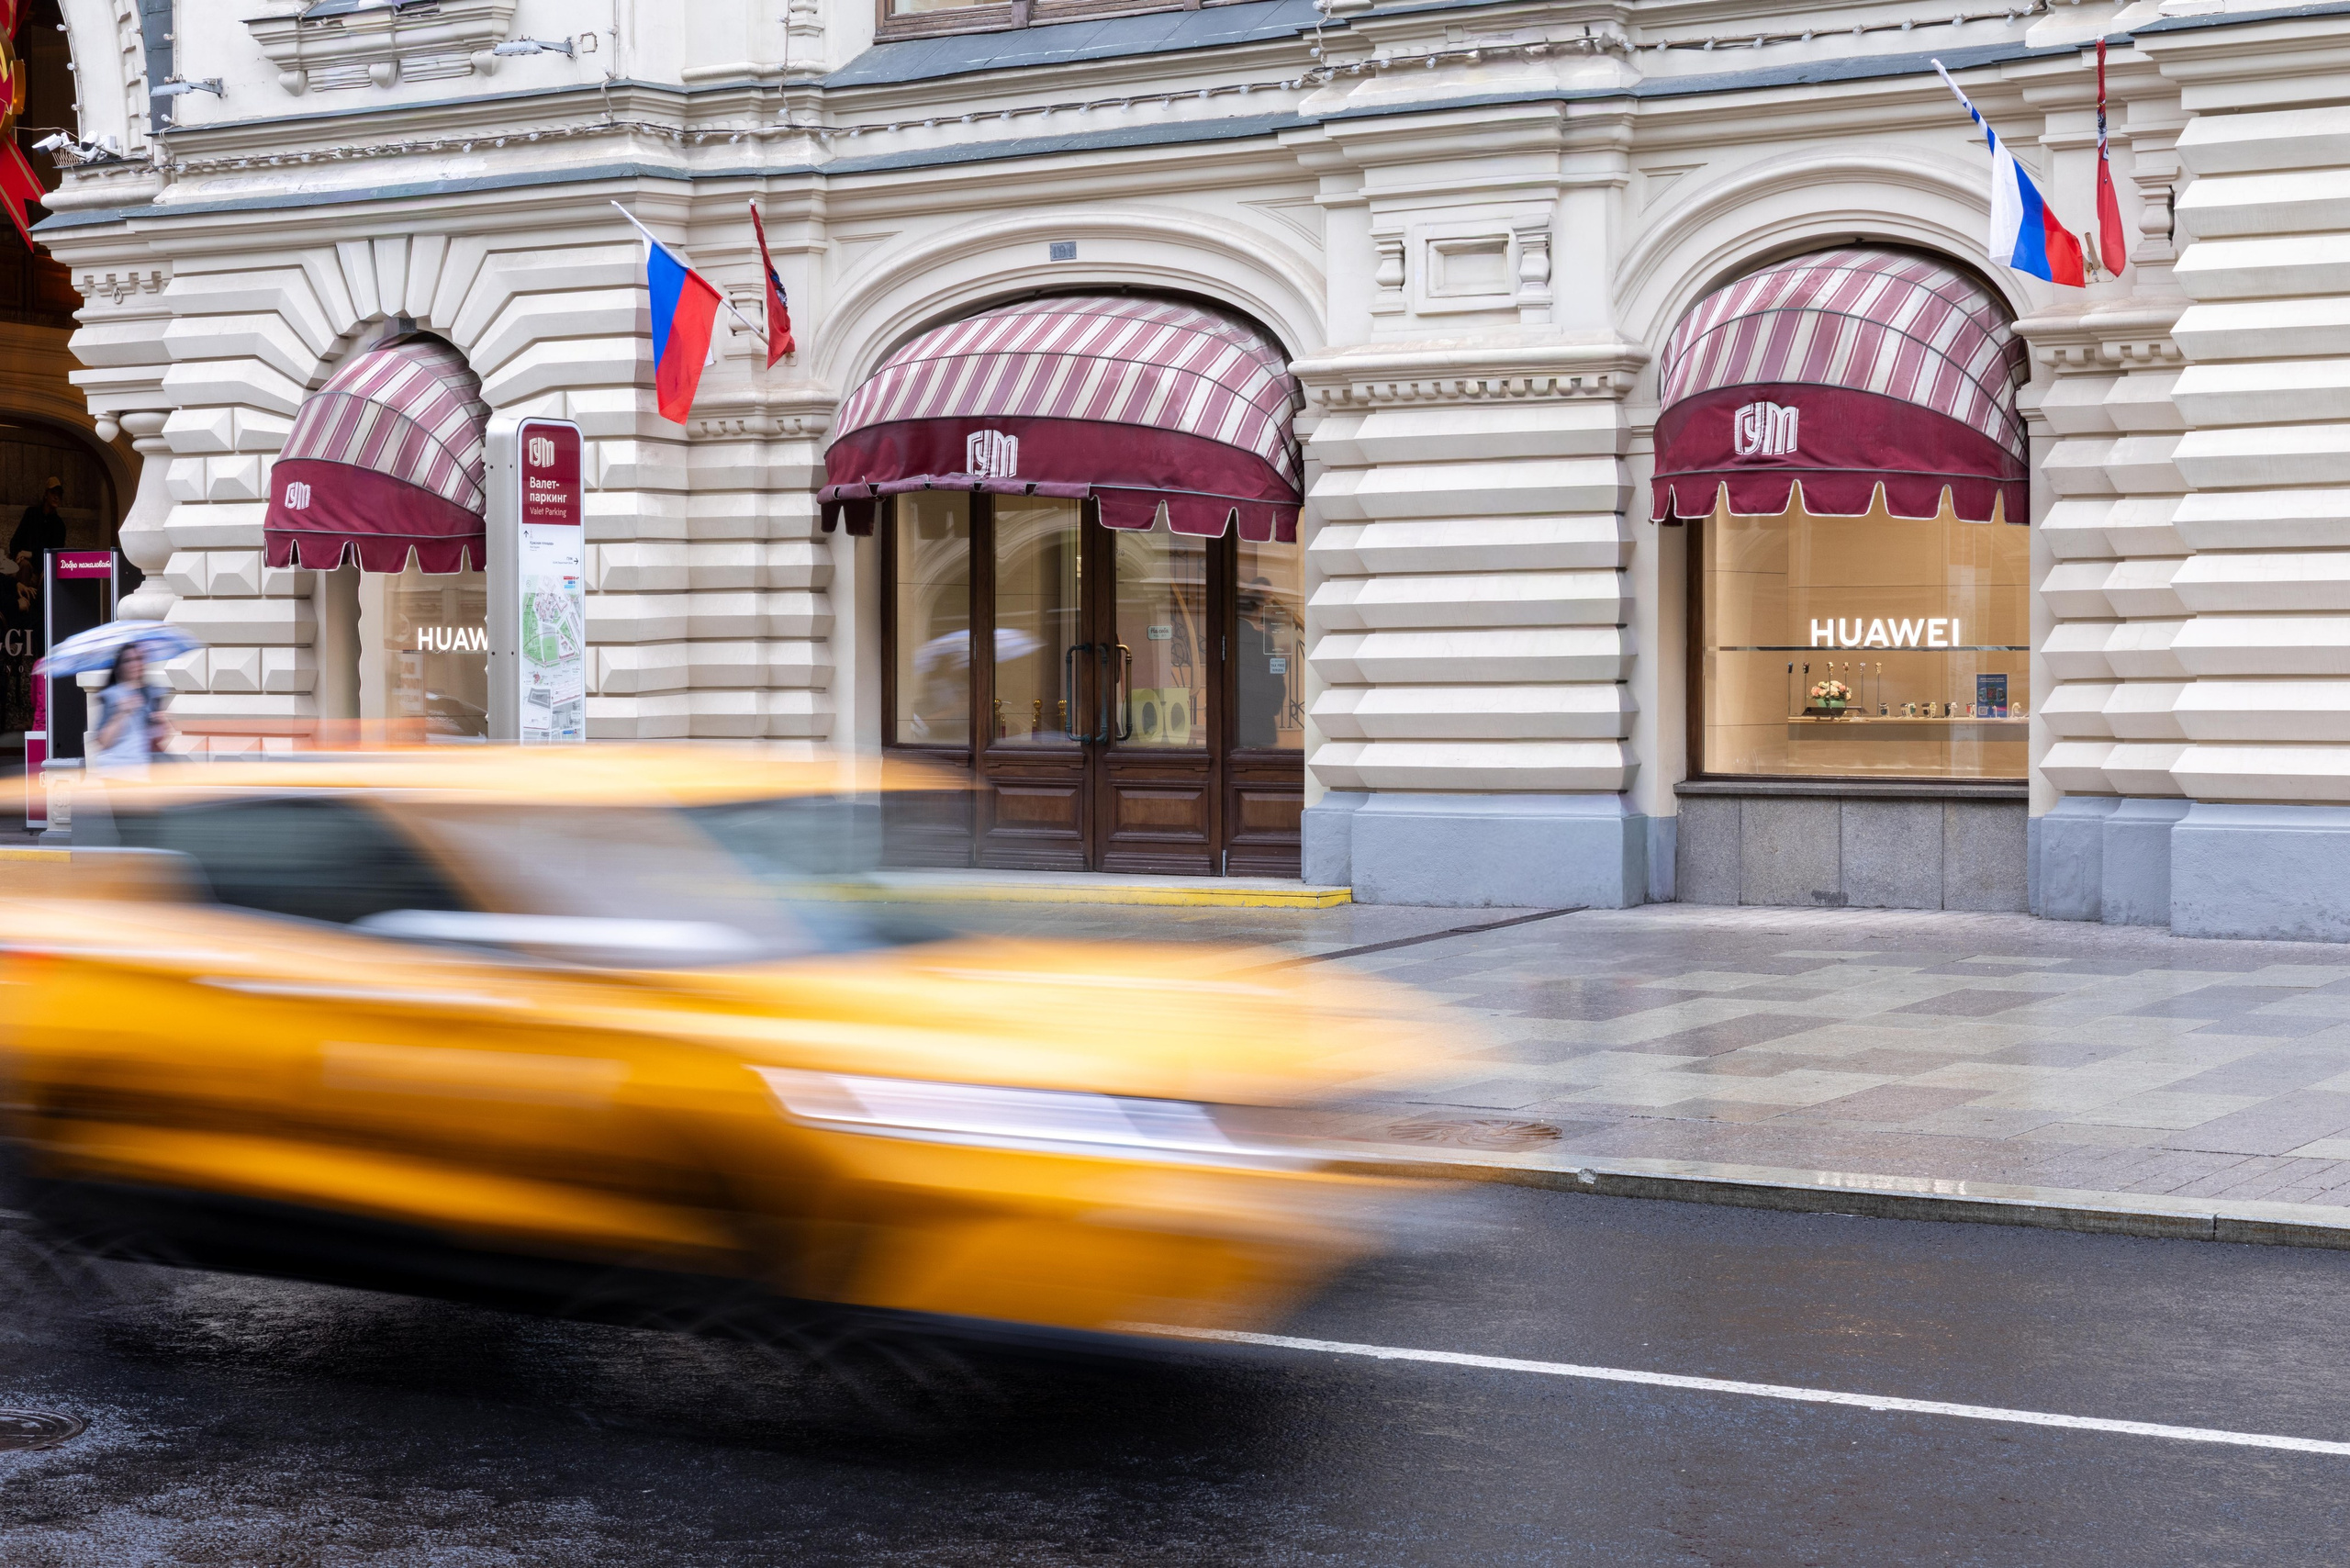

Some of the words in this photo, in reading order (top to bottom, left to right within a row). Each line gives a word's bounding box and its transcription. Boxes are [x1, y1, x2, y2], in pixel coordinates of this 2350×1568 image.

[530, 476, 560, 489] Валет-
[530, 492, 567, 505] паркинг
[530, 507, 544, 516] Valet
[545, 508, 567, 518] Parking
[61, 559, 77, 571] Добро
[1811, 618, 1960, 647] HUAWEI
[0, 628, 33, 656] GI
